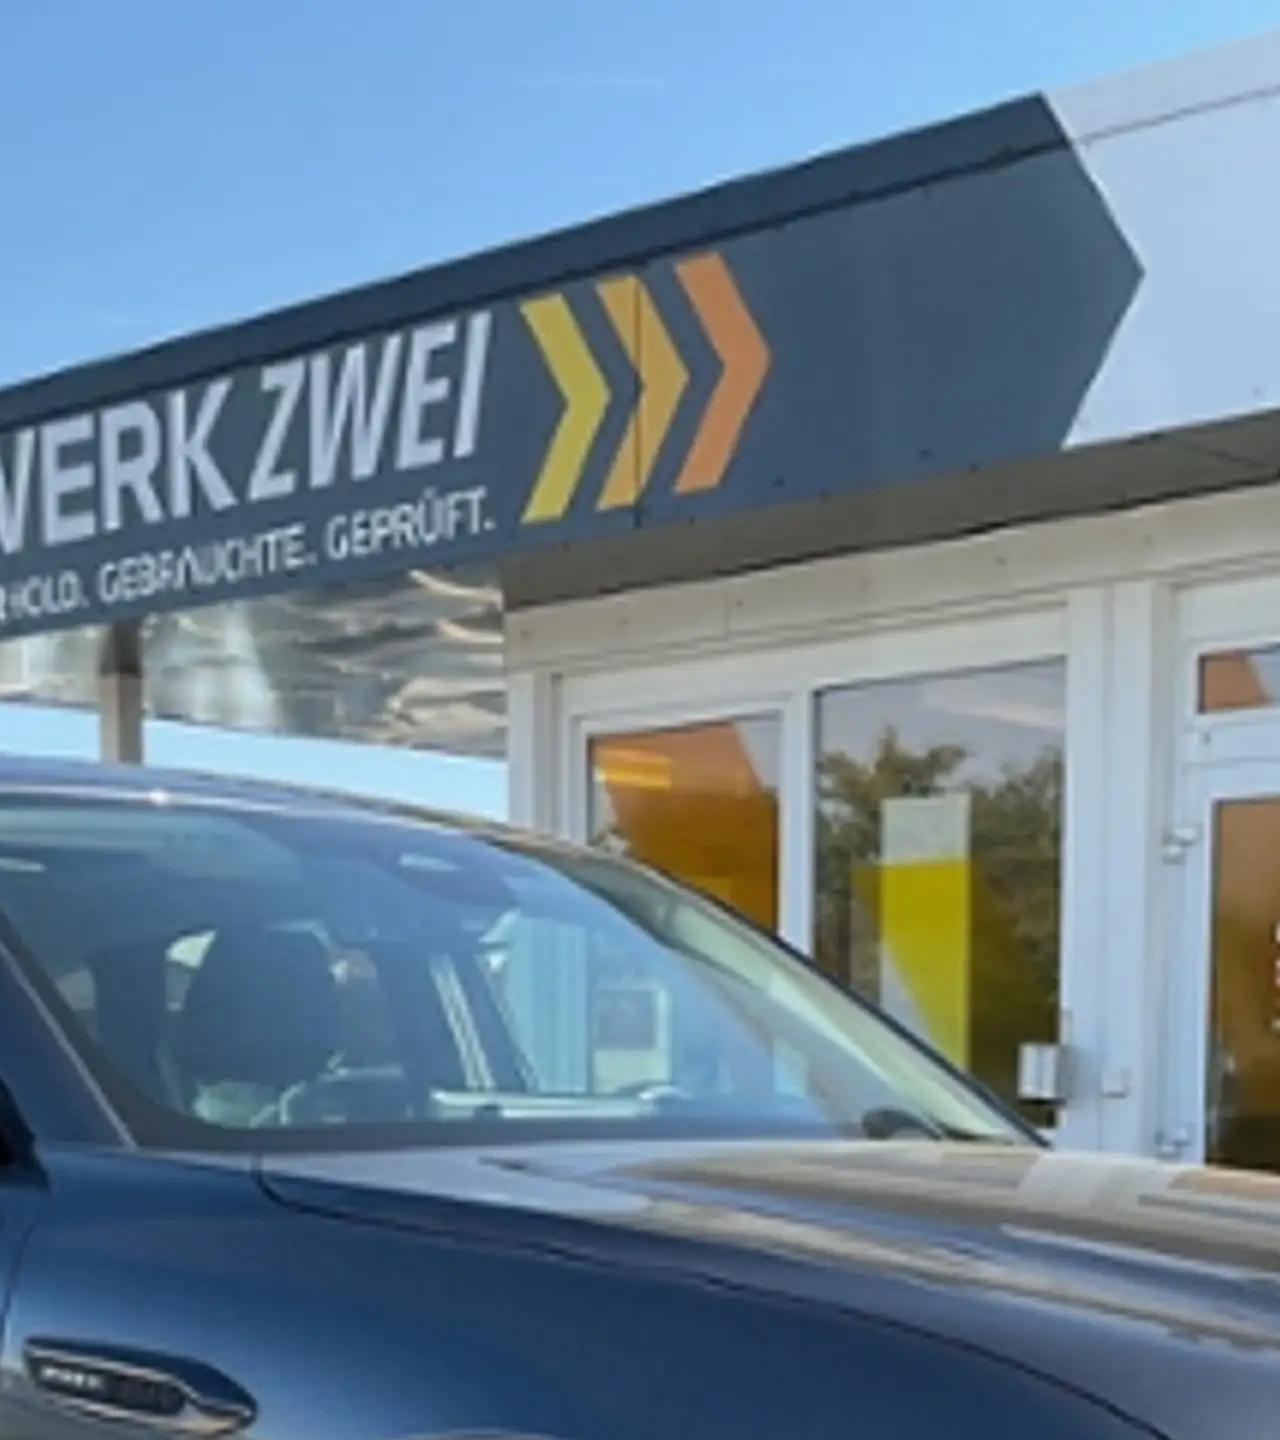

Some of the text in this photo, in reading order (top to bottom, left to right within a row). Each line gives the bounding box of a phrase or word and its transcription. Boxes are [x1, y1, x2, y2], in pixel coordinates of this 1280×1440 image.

[248, 311, 492, 501] ZWEI
[99, 523, 318, 602] GEBRAUCHTE.
[326, 486, 497, 560] GEPRÜFT.
